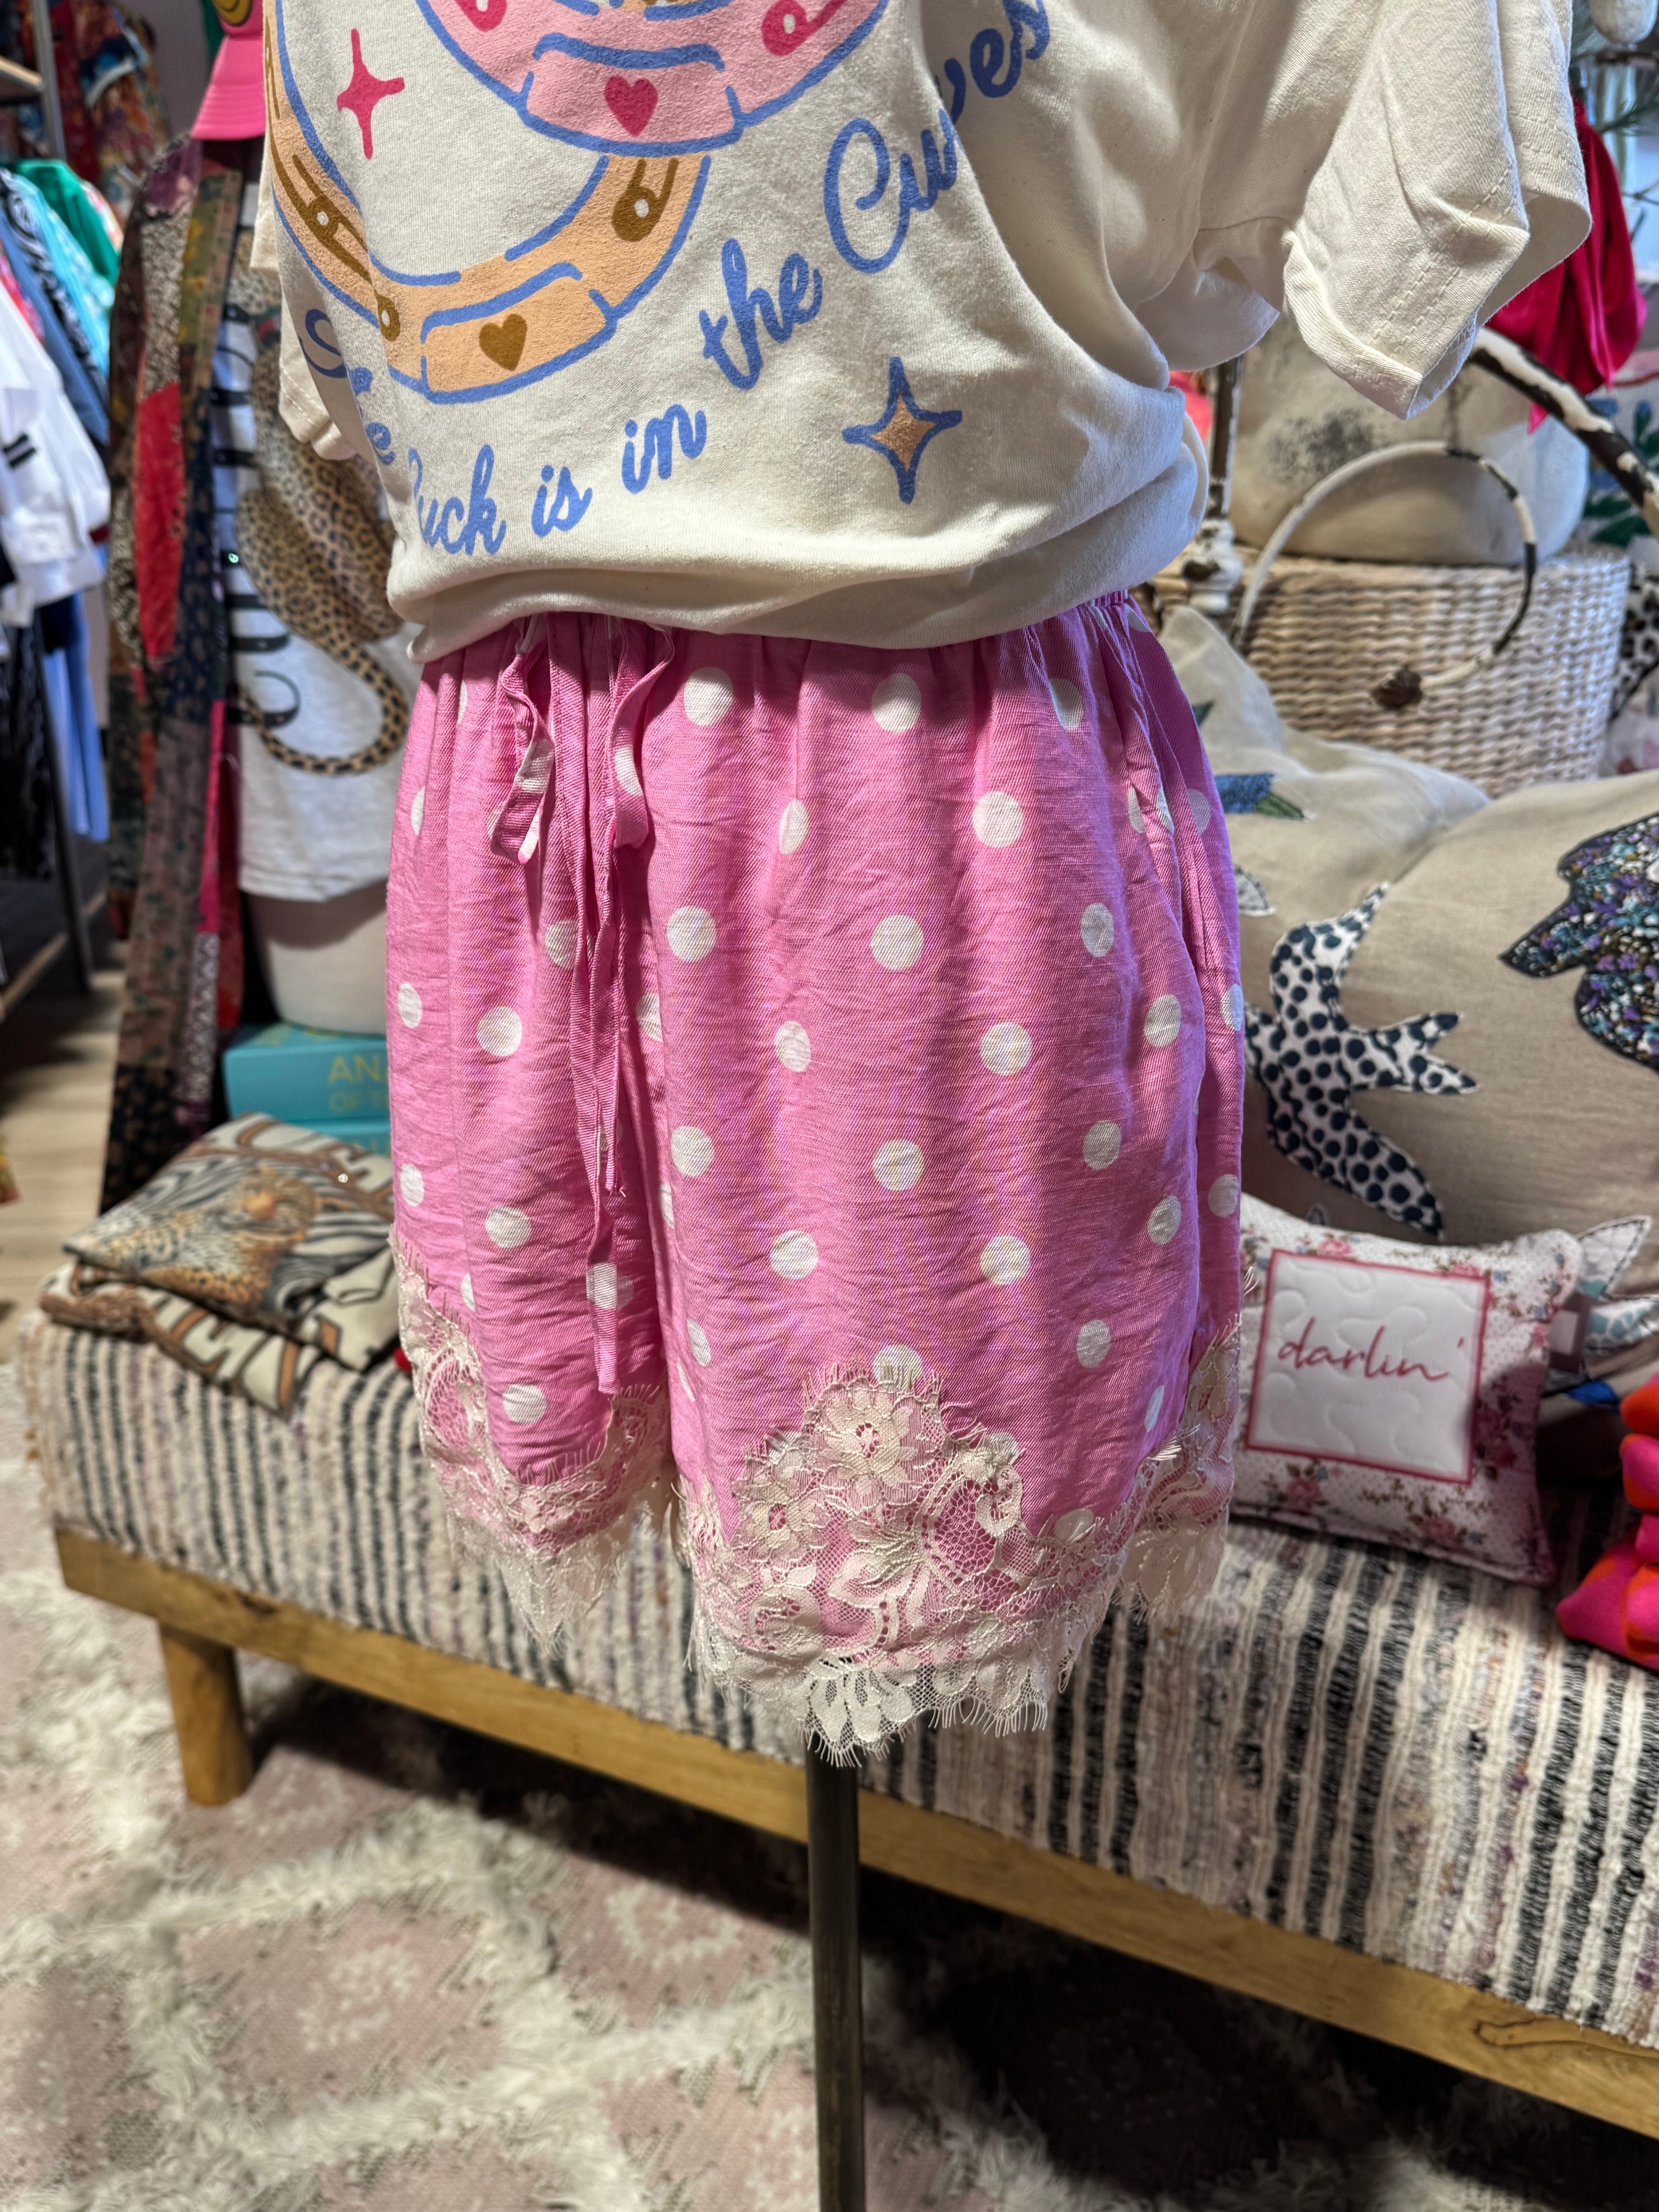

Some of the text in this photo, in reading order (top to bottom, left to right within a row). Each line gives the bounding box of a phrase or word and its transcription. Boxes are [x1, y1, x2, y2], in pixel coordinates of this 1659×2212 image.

[531, 464, 593, 538] is
[622, 404, 707, 495] in
[699, 238, 823, 391] the
[328, 1054, 388, 1082] AN
[1278, 1316, 1464, 1381] darlin'
